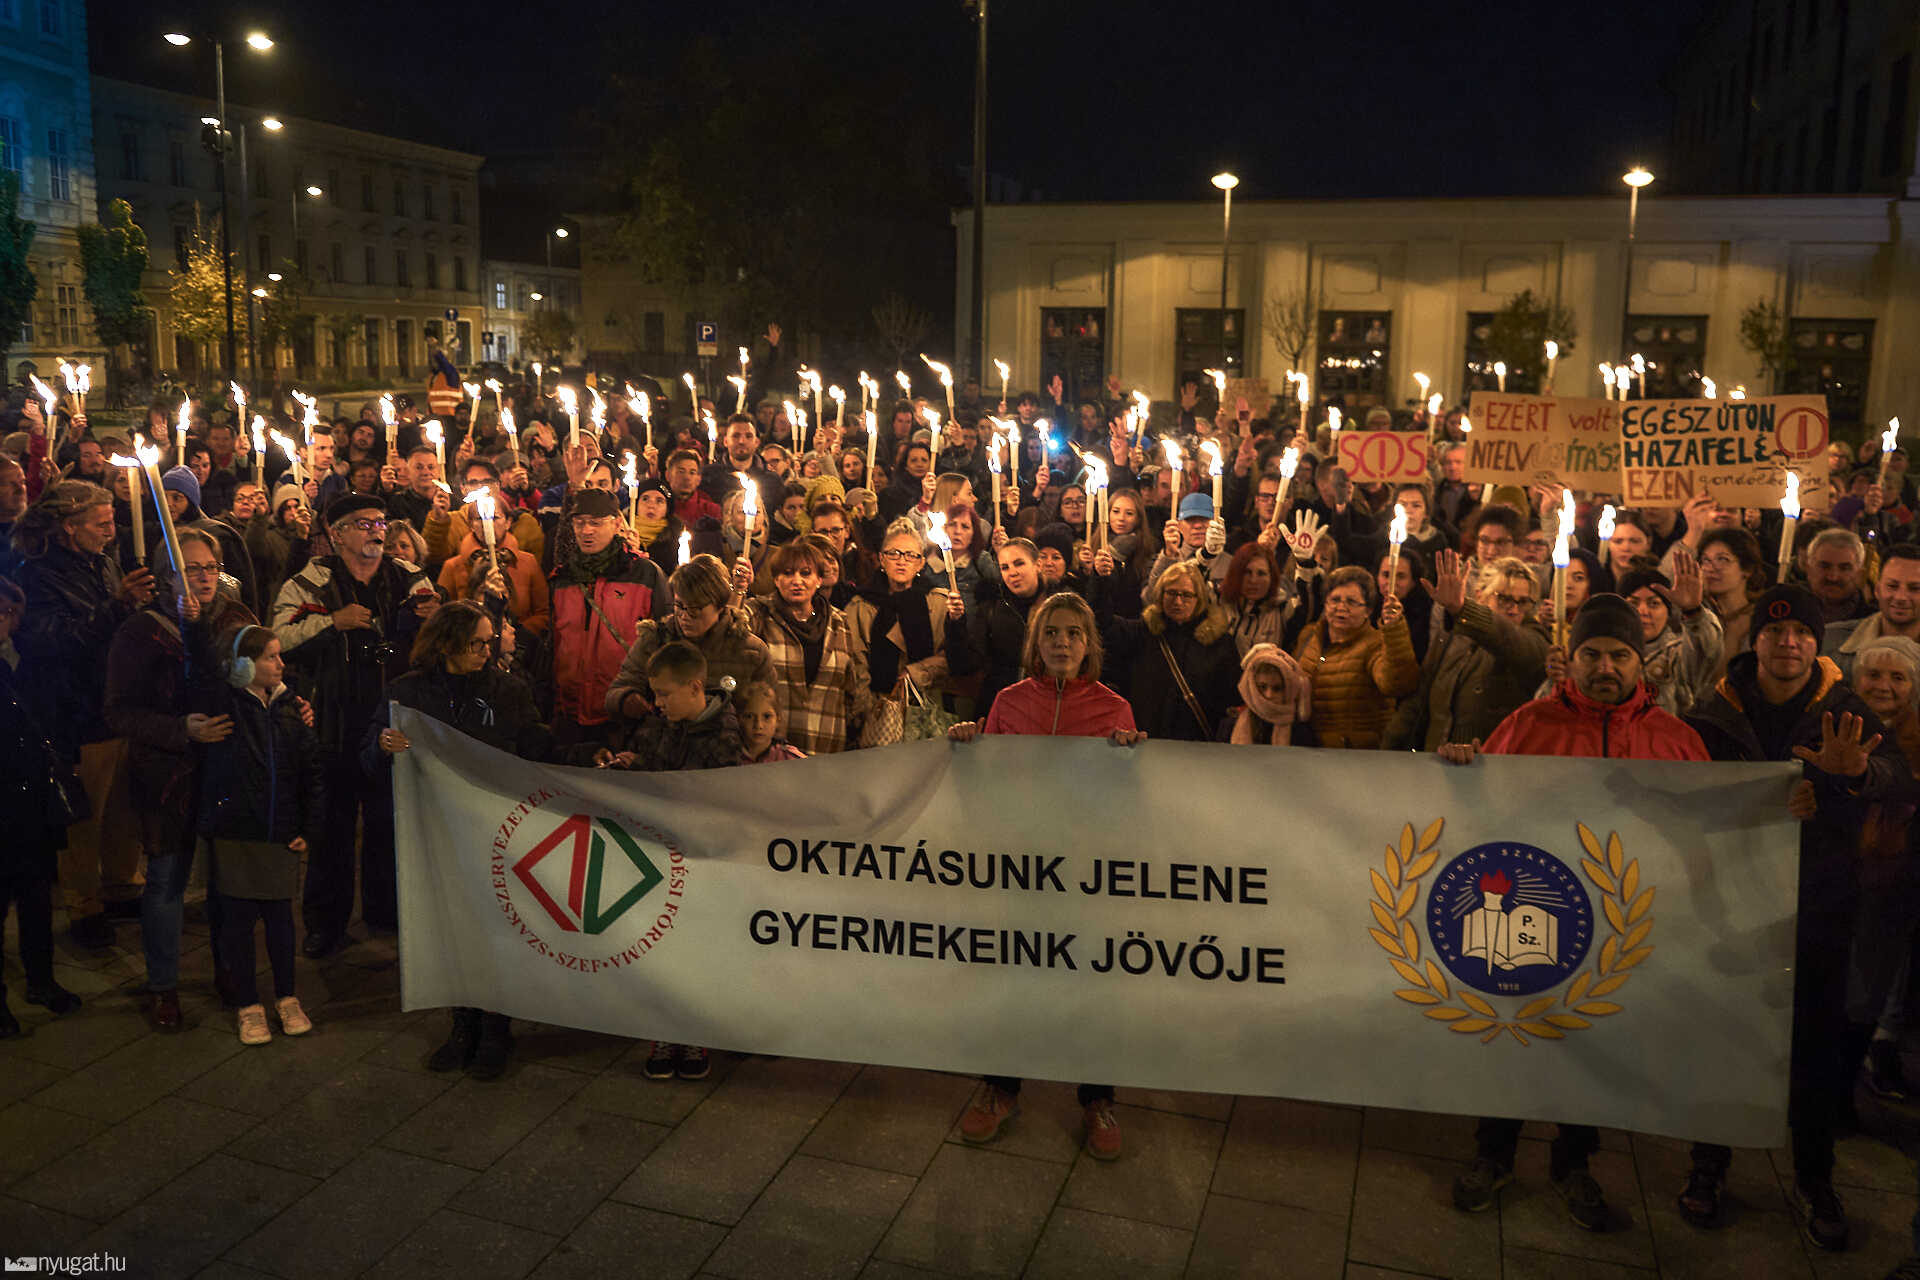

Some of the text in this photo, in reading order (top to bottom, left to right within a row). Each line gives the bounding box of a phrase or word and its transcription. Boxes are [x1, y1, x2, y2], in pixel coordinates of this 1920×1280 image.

[702, 325, 713, 340] P
[1486, 398, 1611, 432] EZÉRT volt
[1622, 402, 1776, 438] EGÉSZ ÚTON
[1624, 434, 1771, 468] HAZAFELÉ
[1627, 469, 1695, 501] EZEN
[767, 838, 1268, 905] OKTATÁSUNK JELENE
[608, 901, 680, 970] FÓRUMA
[1522, 915, 1537, 928] P.
[749, 909, 1287, 984] GYERMEKEINK JÖVŐJE
[1518, 932, 1542, 946] Sz.
[555, 951, 601, 974] SZEF
